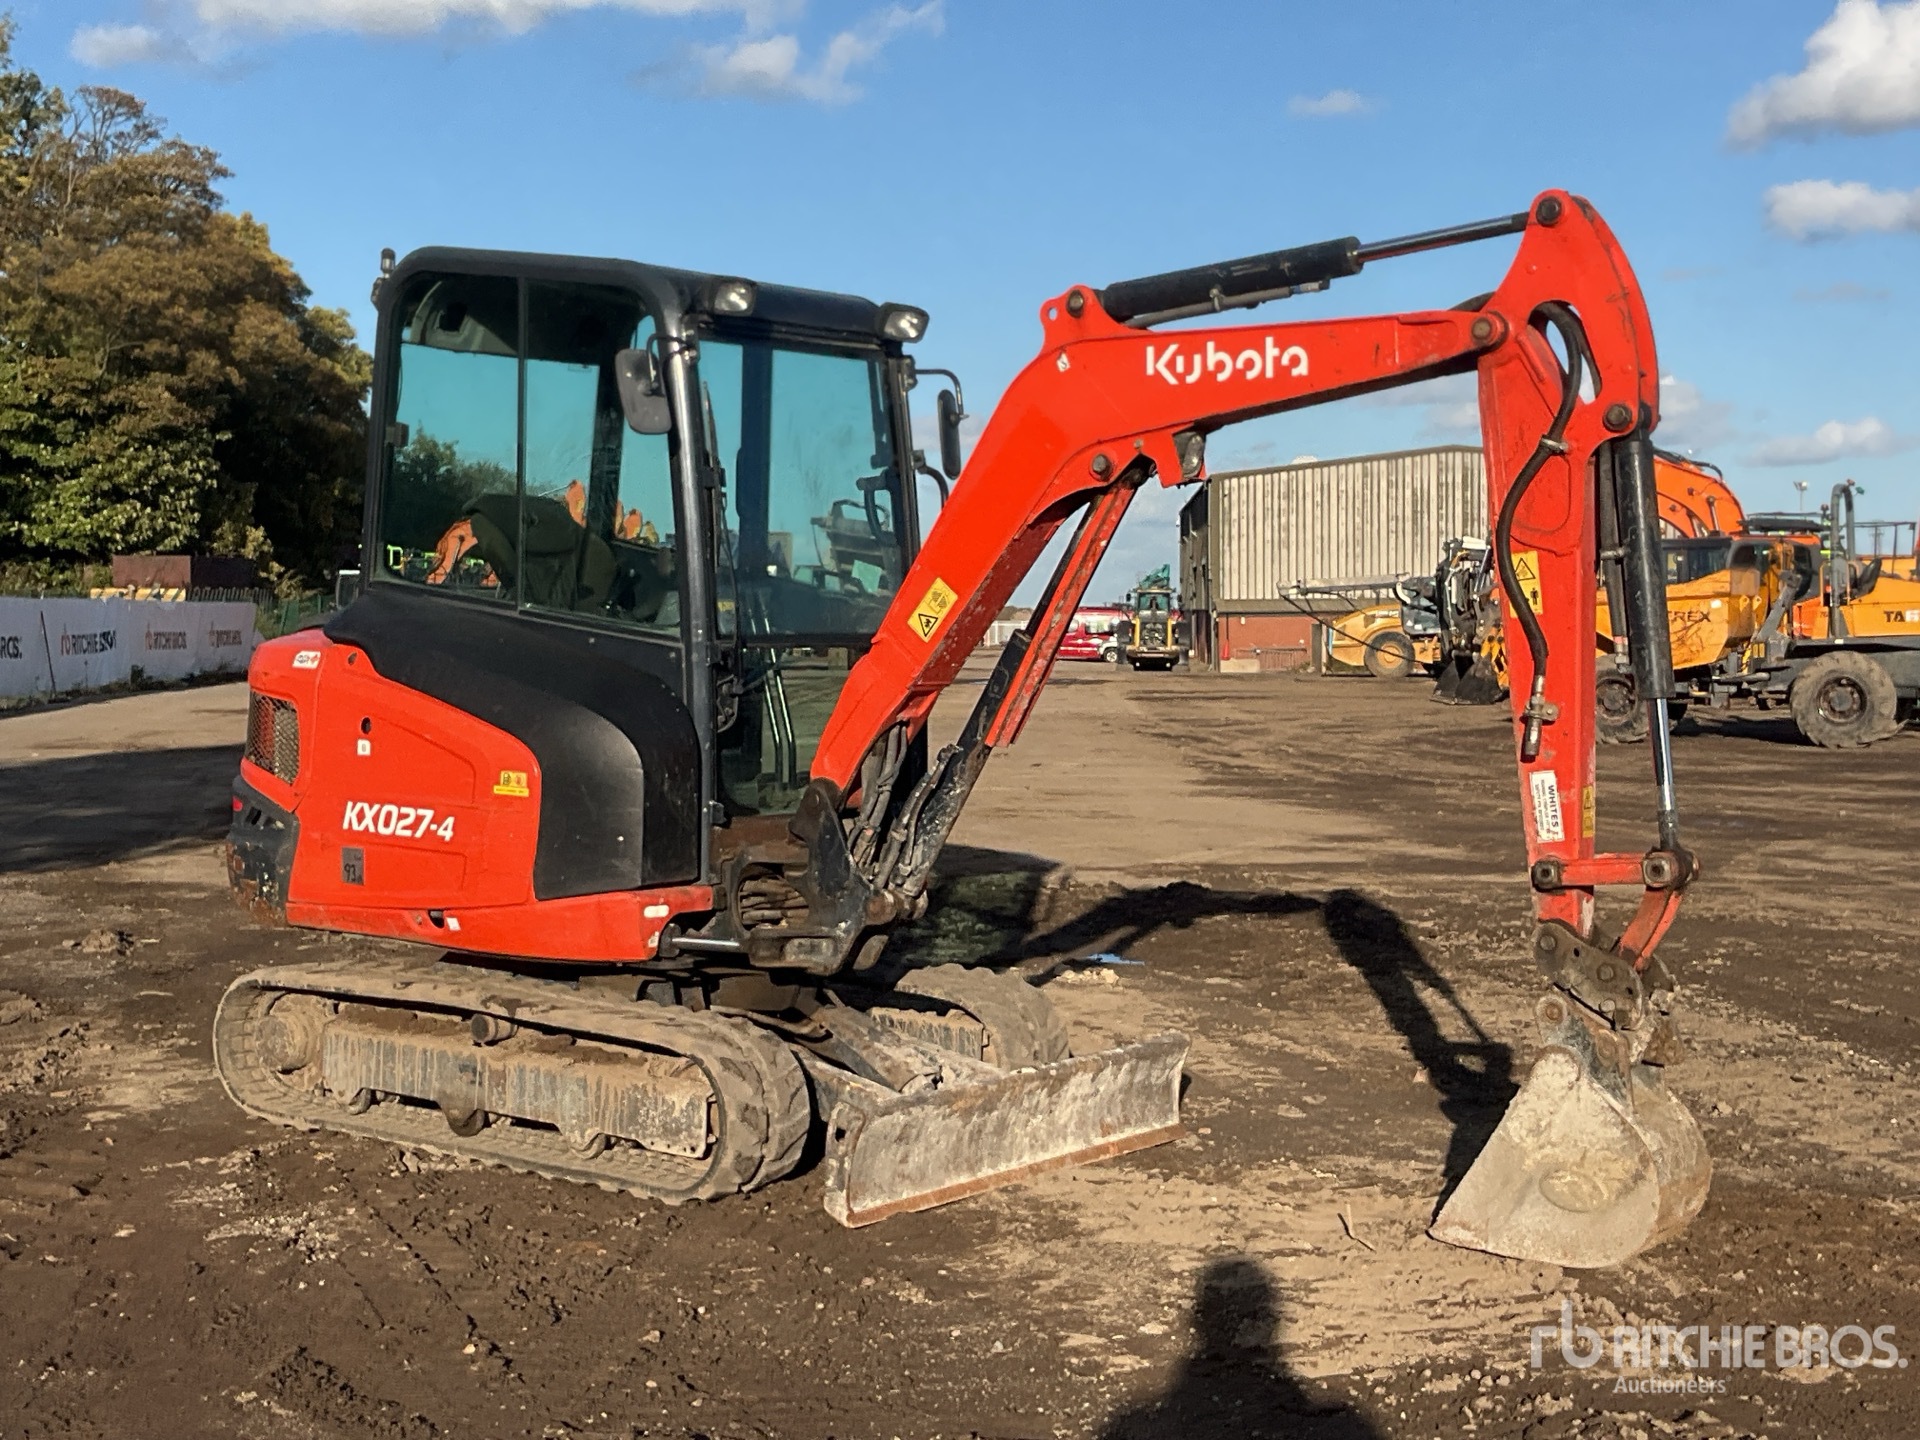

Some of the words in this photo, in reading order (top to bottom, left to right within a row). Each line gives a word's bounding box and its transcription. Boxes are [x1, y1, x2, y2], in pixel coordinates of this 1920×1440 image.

[1146, 336, 1309, 385] Kubota
[342, 801, 455, 841] KX027-4
[1547, 785, 1559, 828] WHITES
